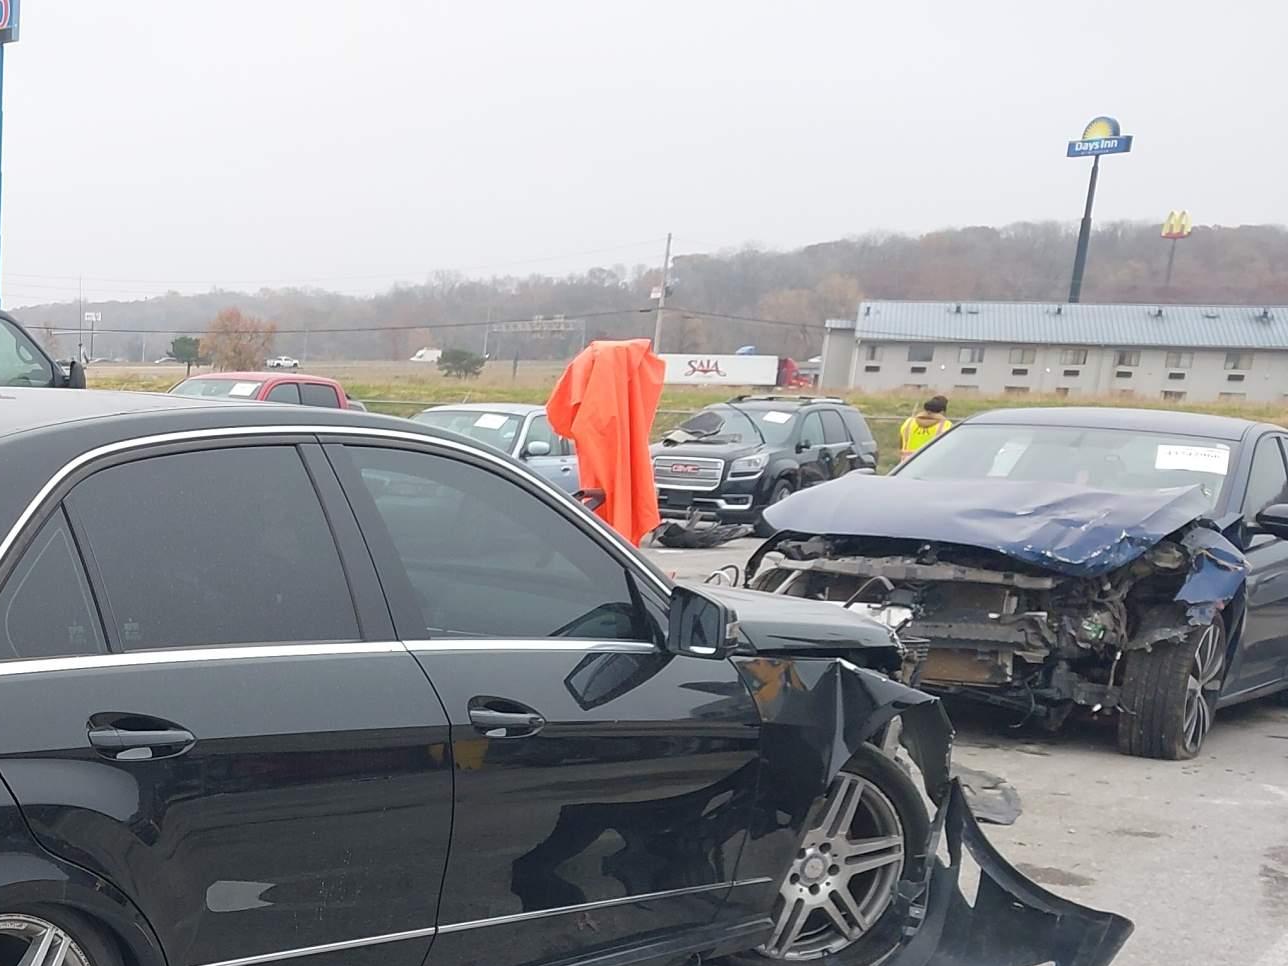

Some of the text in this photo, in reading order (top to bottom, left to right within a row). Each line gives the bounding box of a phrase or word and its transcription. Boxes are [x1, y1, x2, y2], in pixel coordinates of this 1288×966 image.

[1075, 141, 1100, 152] Days
[1101, 139, 1118, 149] Inn
[684, 359, 727, 377] SAIA
[672, 463, 699, 473] GMC
